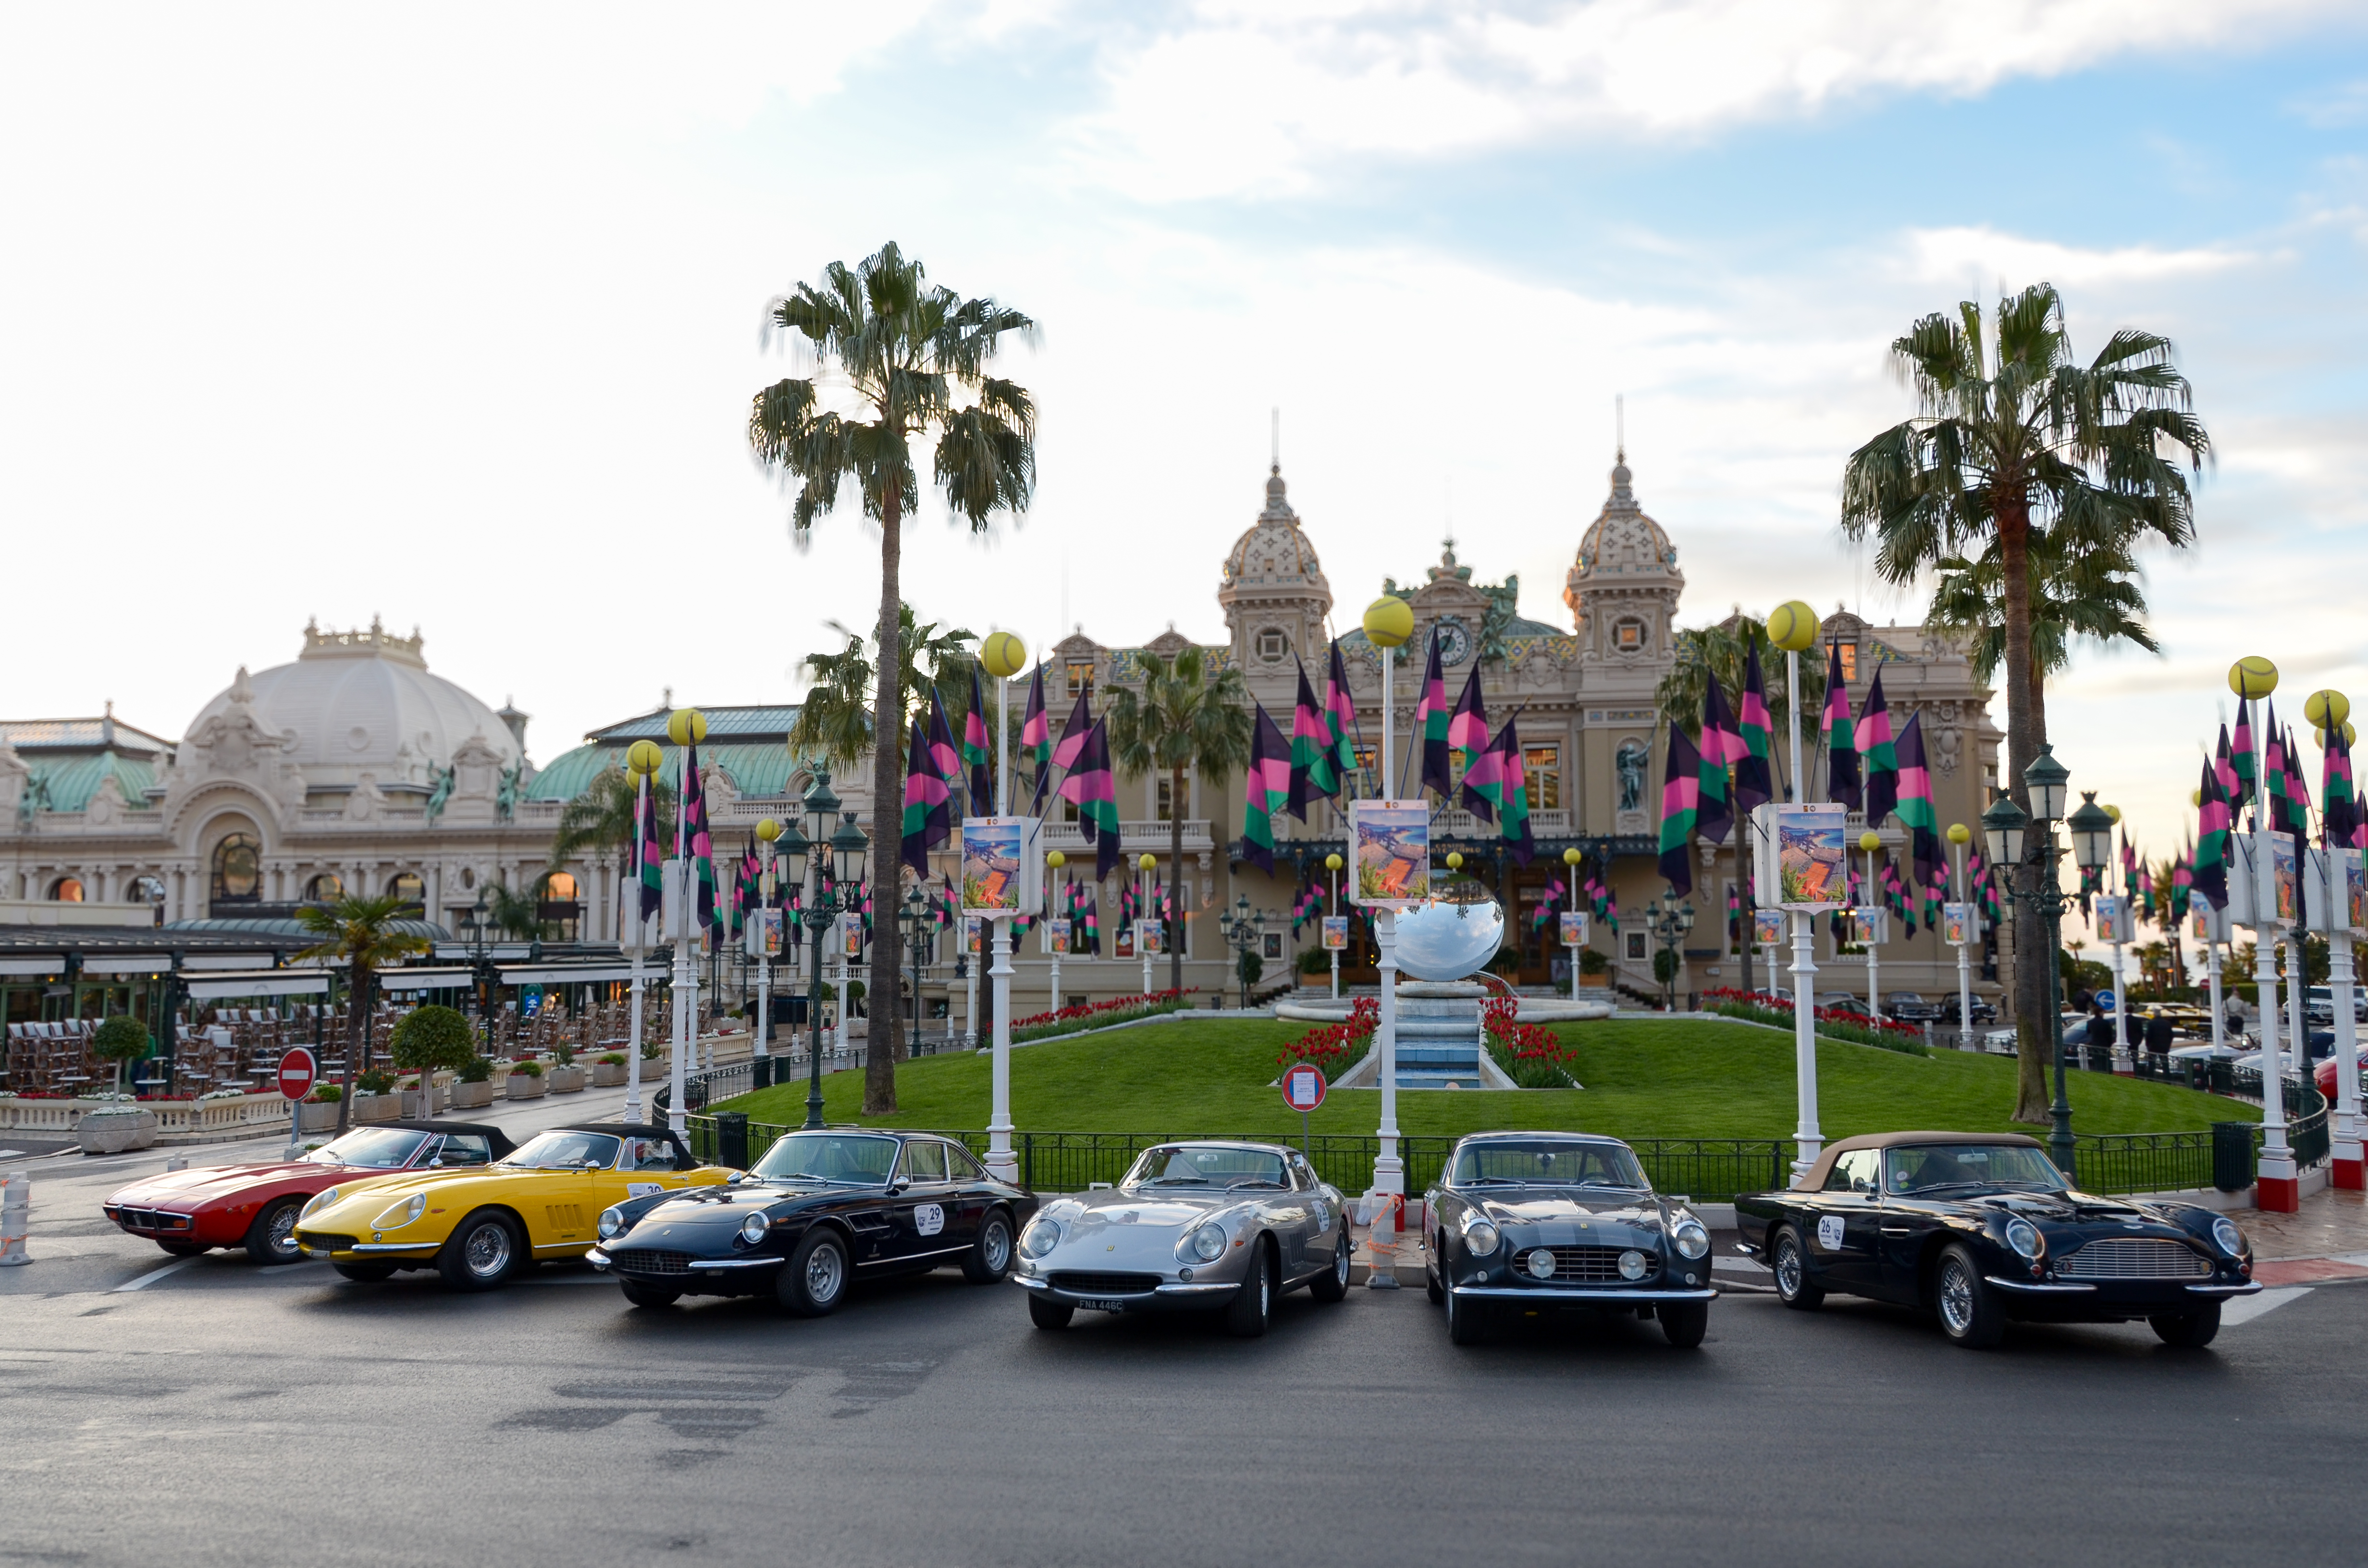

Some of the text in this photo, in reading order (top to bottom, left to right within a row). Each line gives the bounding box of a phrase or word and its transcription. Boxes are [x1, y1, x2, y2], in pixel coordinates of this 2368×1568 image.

[648, 1186, 661, 1194] 30
[929, 1207, 940, 1220] 29
[1821, 1219, 1830, 1234] 26
[1080, 1299, 1122, 1310] FNA 446C
